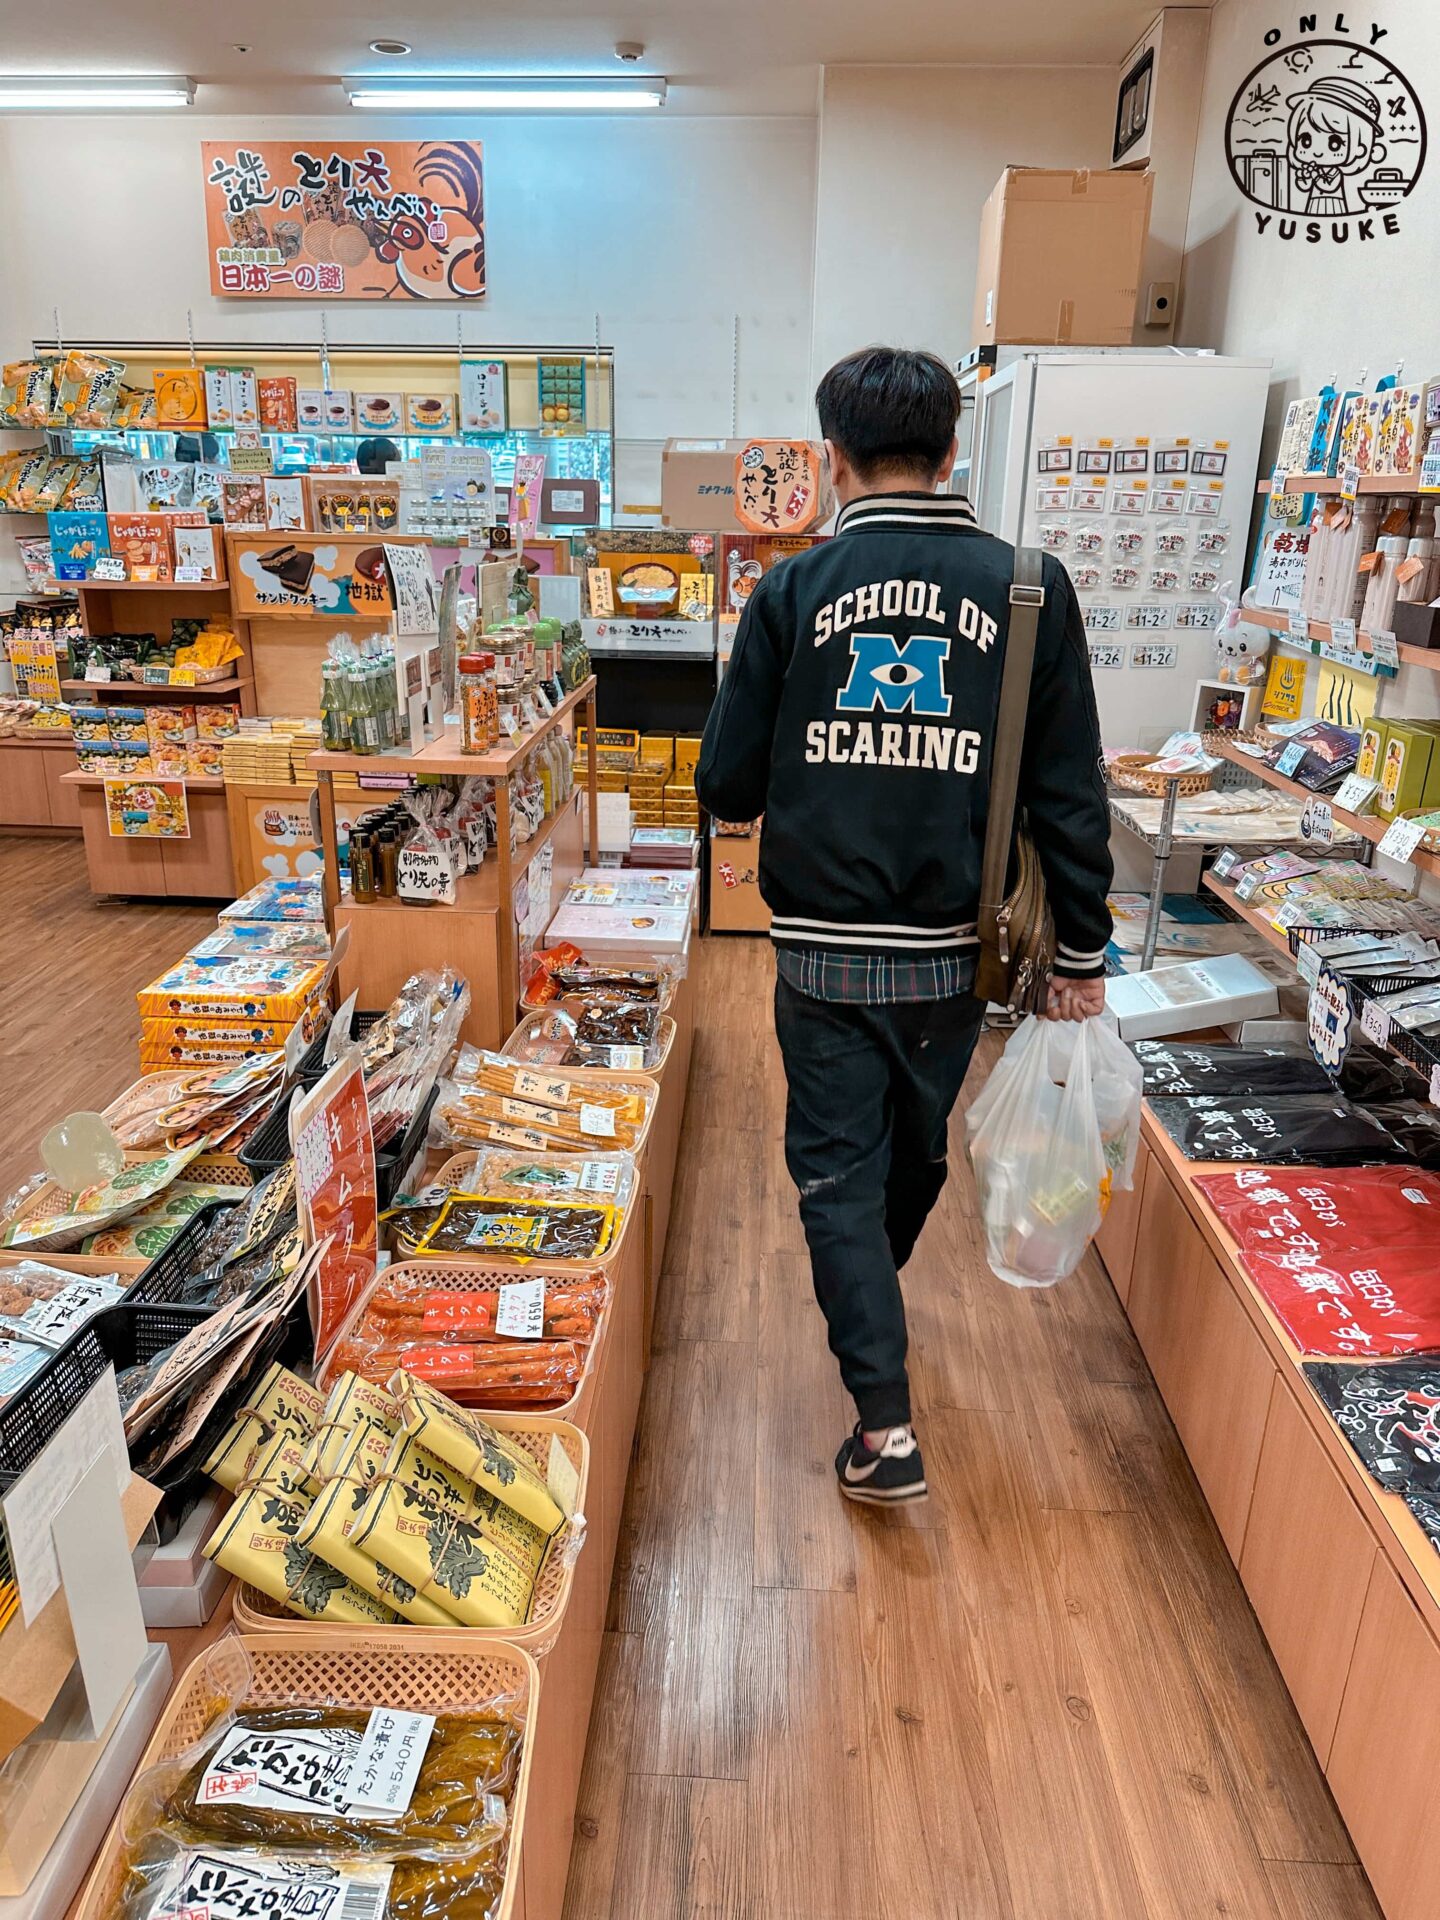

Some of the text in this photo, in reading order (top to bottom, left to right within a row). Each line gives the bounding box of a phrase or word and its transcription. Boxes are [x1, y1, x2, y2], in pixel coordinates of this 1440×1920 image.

[221, 265, 343, 289] 日本一の謎
[760, 465, 780, 528] とり天
[256, 592, 327, 607] サンドクッキー
[814, 579, 998, 654] SCHOOL OF
[836, 632, 953, 717] M
[805, 720, 982, 774] SCARING
[1388, 829, 1410, 846] ¥330
[1365, 1011, 1382, 1034] ¥360
[1297, 1187, 1347, 1227] 毎日が
[488, 1221, 523, 1237] ゆず
[1349, 1269, 1404, 1317] 毎日が
[426, 1303, 488, 1318] キムタク
[404, 1352, 471, 1370] キムタク
[356, 1714, 396, 1796] たかな漬け
[389, 1734, 416, 1783] 540円
[385, 1783, 402, 1805] 800g
